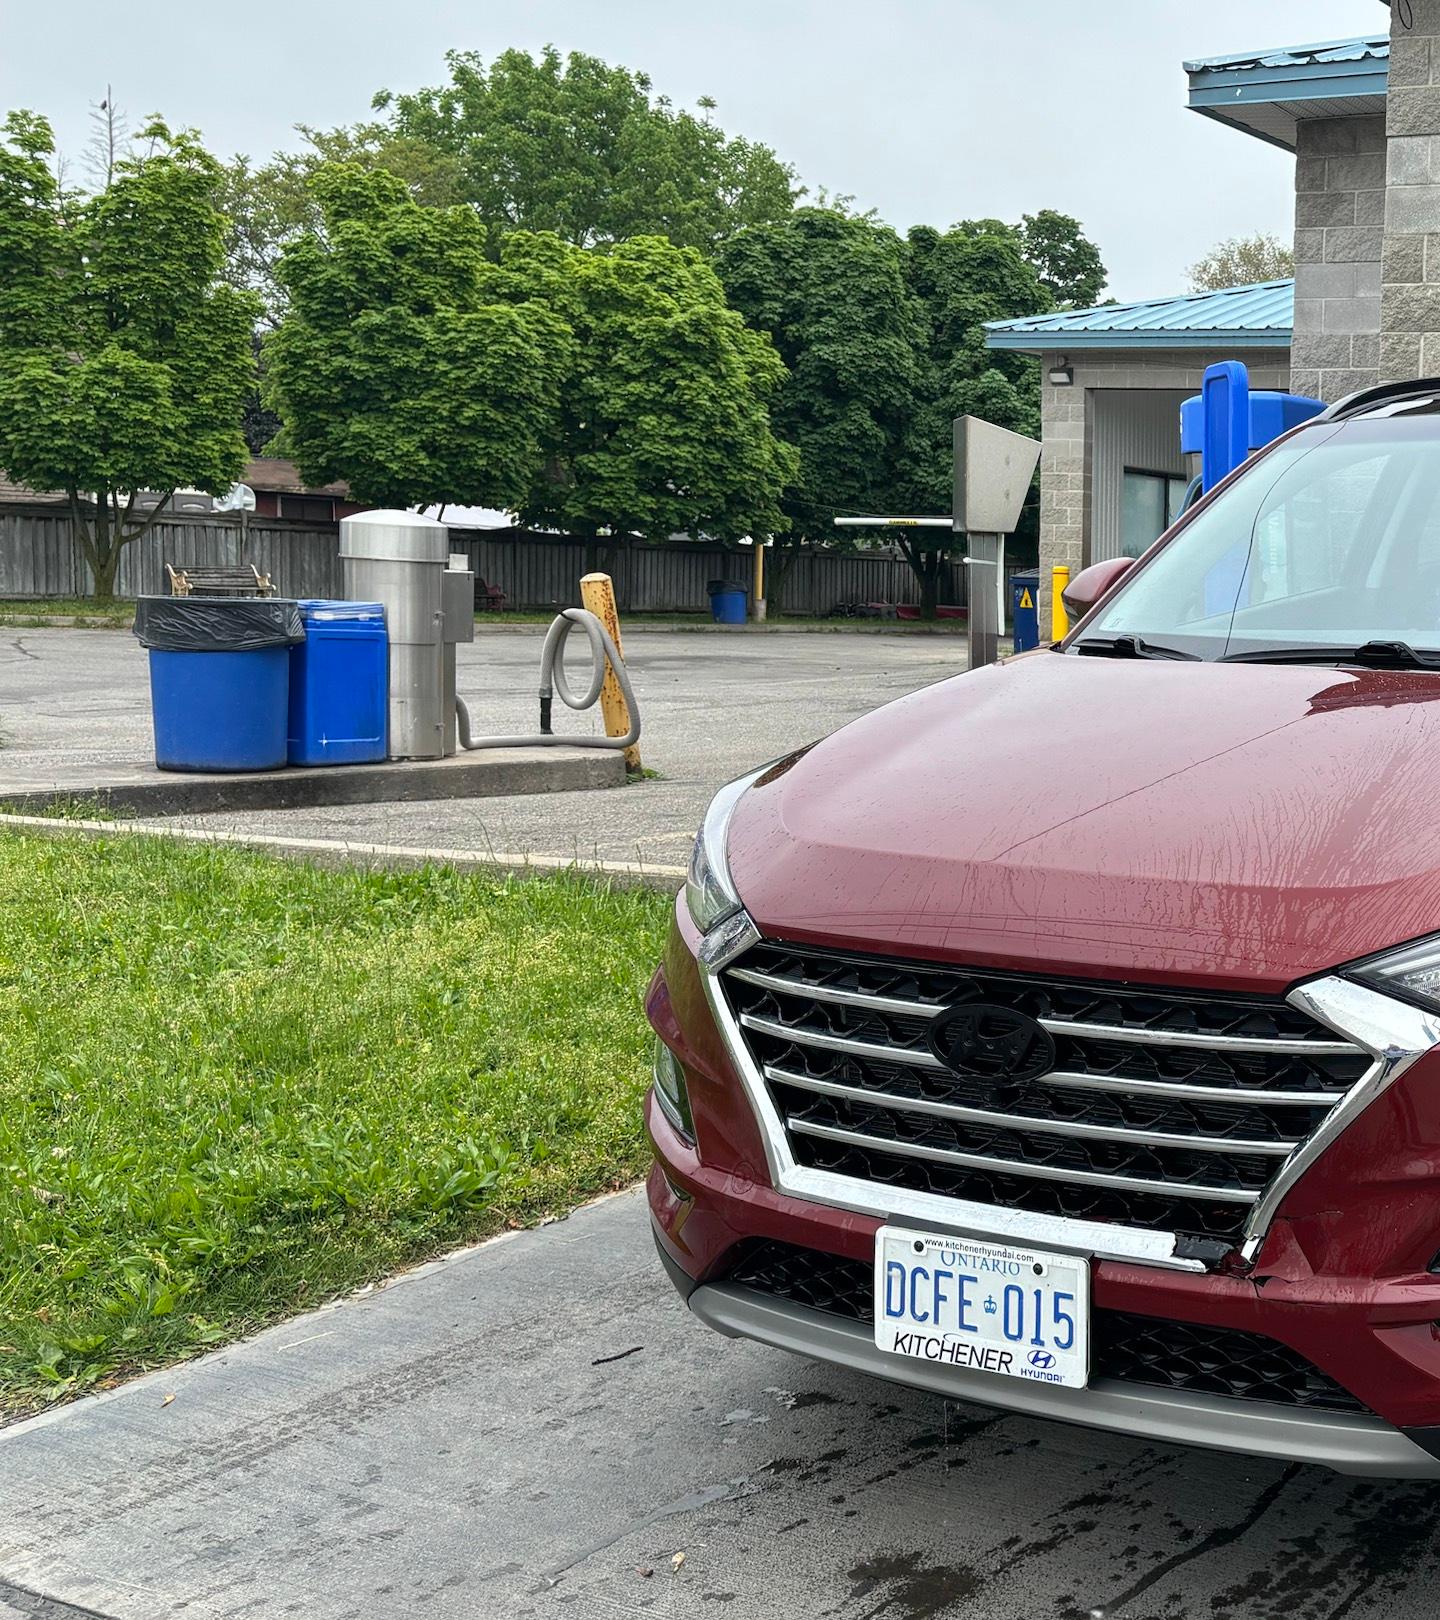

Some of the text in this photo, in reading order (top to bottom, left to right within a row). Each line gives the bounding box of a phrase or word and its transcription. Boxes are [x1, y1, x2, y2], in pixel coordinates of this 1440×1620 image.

[924, 1237, 1034, 1263] www.kitchenerhyundai.com
[940, 1249, 1021, 1277] ONTARIO
[885, 1260, 1074, 1350] DCFE 015
[893, 1332, 1013, 1373] KITCHENER
[1020, 1367, 1064, 1384] HYUNDAI
